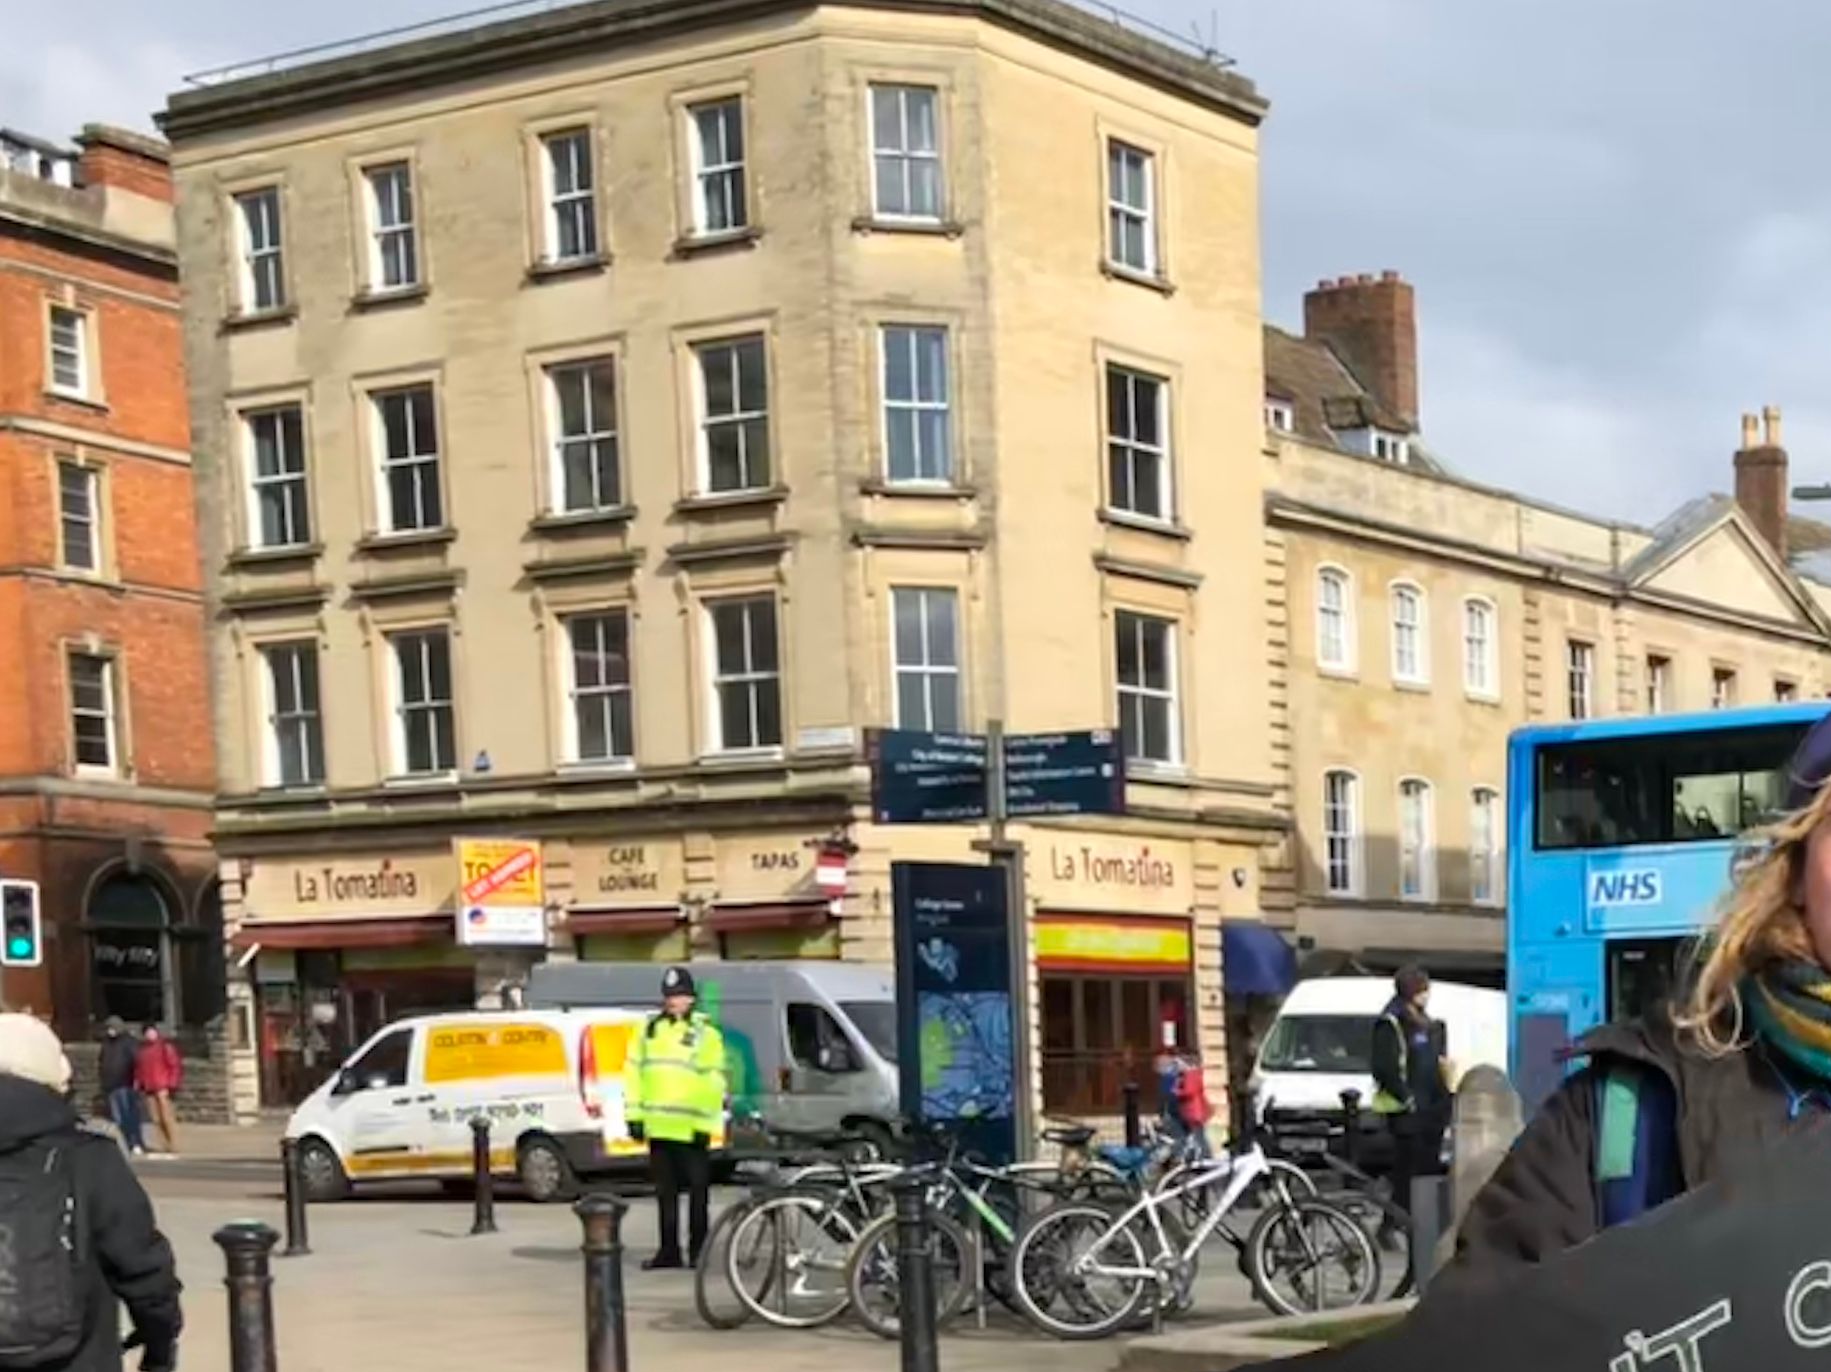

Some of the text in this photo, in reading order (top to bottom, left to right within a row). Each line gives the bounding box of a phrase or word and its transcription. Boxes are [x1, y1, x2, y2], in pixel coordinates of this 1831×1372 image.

[751, 854, 799, 870] TAPAS
[1051, 844, 1174, 887] La Tomatina
[295, 858, 417, 902] La Tomatina
[598, 873, 658, 892] LOUNGE
[1593, 872, 1657, 902] NHS
